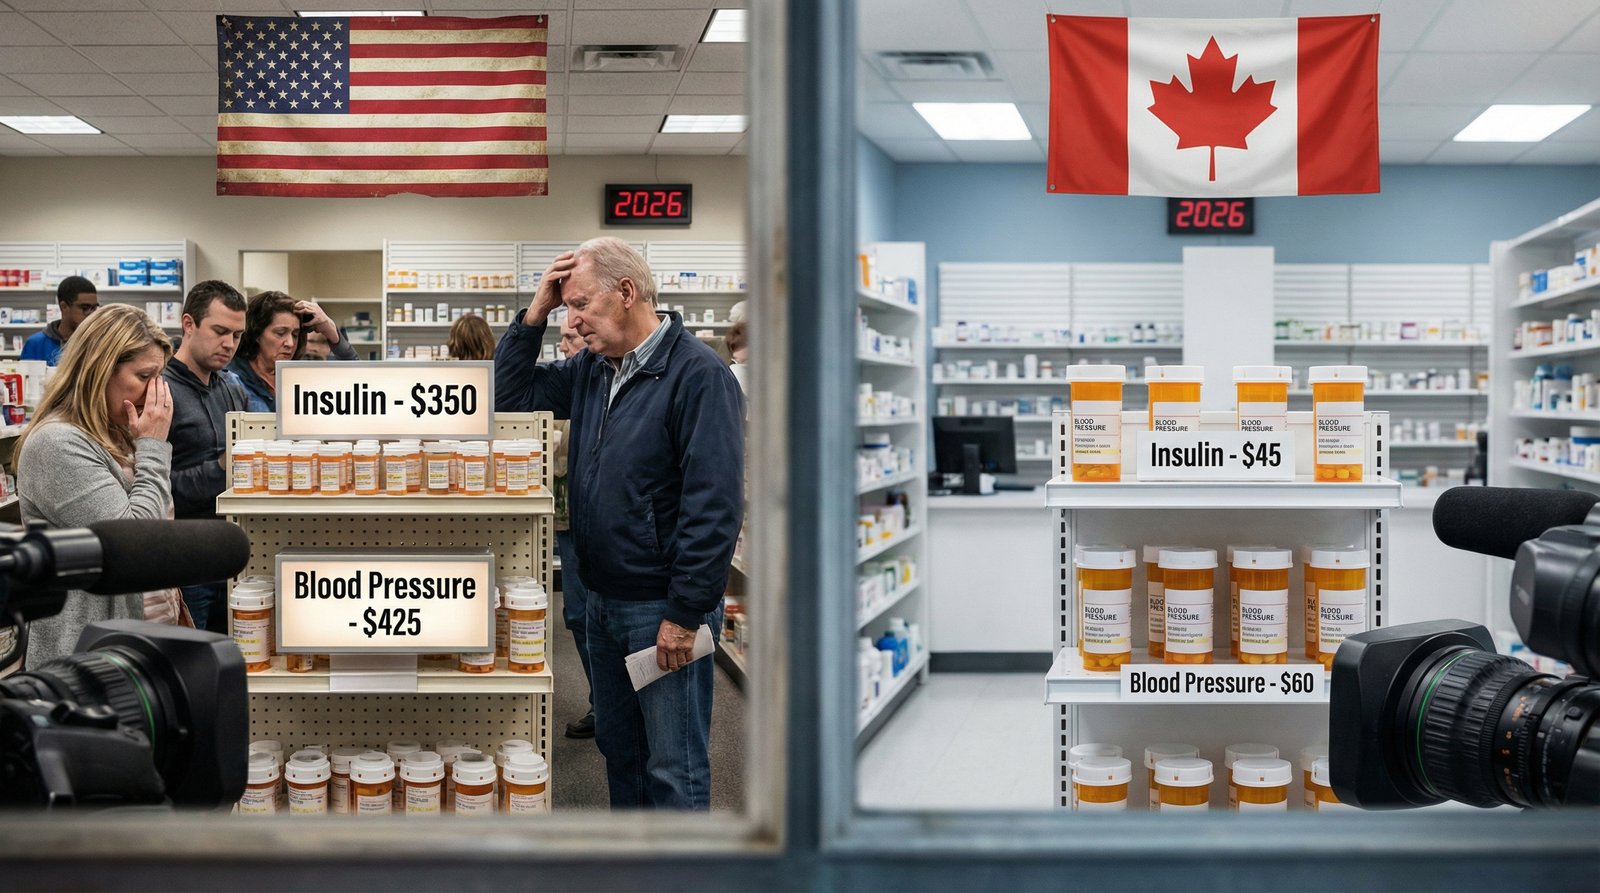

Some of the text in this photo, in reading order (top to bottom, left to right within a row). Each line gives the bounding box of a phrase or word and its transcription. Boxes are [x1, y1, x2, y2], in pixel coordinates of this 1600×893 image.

[614, 191, 683, 218] 2026
[1175, 200, 1246, 228] 2026
[294, 383, 386, 416] Insulin
[410, 382, 477, 418] $350
[1151, 440, 1224, 467] Insulin
[1242, 440, 1282, 470] $45
[295, 570, 476, 600] Blood Pressure
[363, 606, 421, 639] $425
[1242, 613, 1275, 621] PRESSURE
[1321, 613, 1354, 621] PRESSURE
[1130, 671, 1180, 694] Blood
[1185, 672, 1266, 694] Pressure
[1280, 671, 1314, 695] $60
